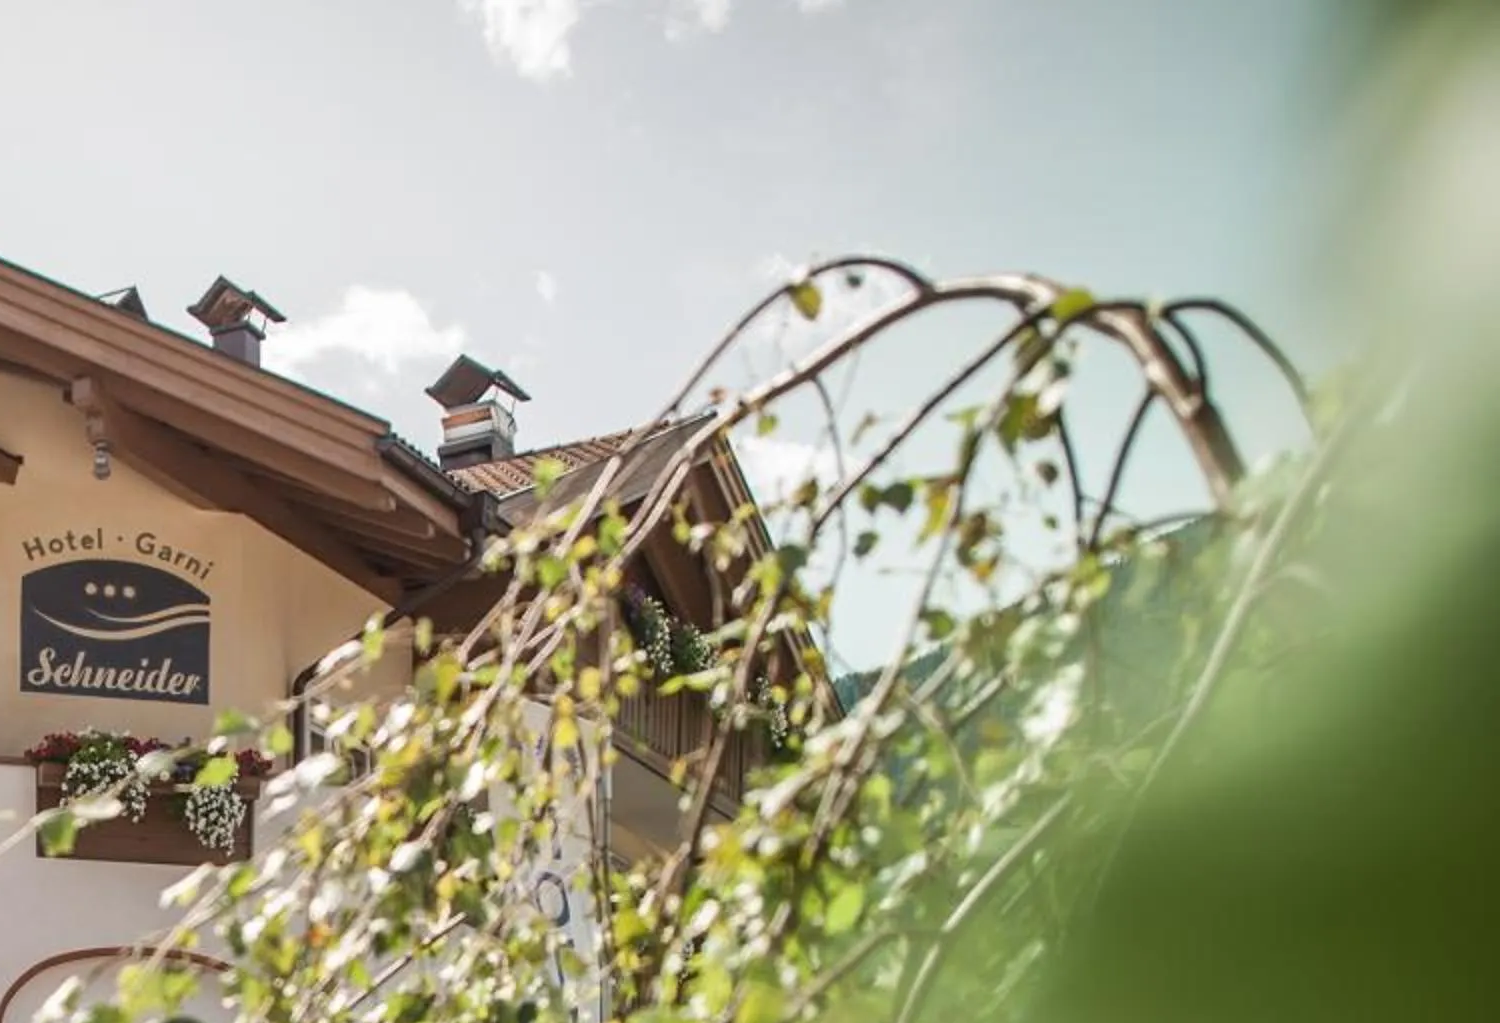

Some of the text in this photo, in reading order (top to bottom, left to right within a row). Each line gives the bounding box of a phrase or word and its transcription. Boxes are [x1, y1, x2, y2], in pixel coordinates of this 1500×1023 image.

[22, 528, 103, 561] Hotel
[135, 532, 215, 580] Garni
[27, 647, 201, 696] Schneider
